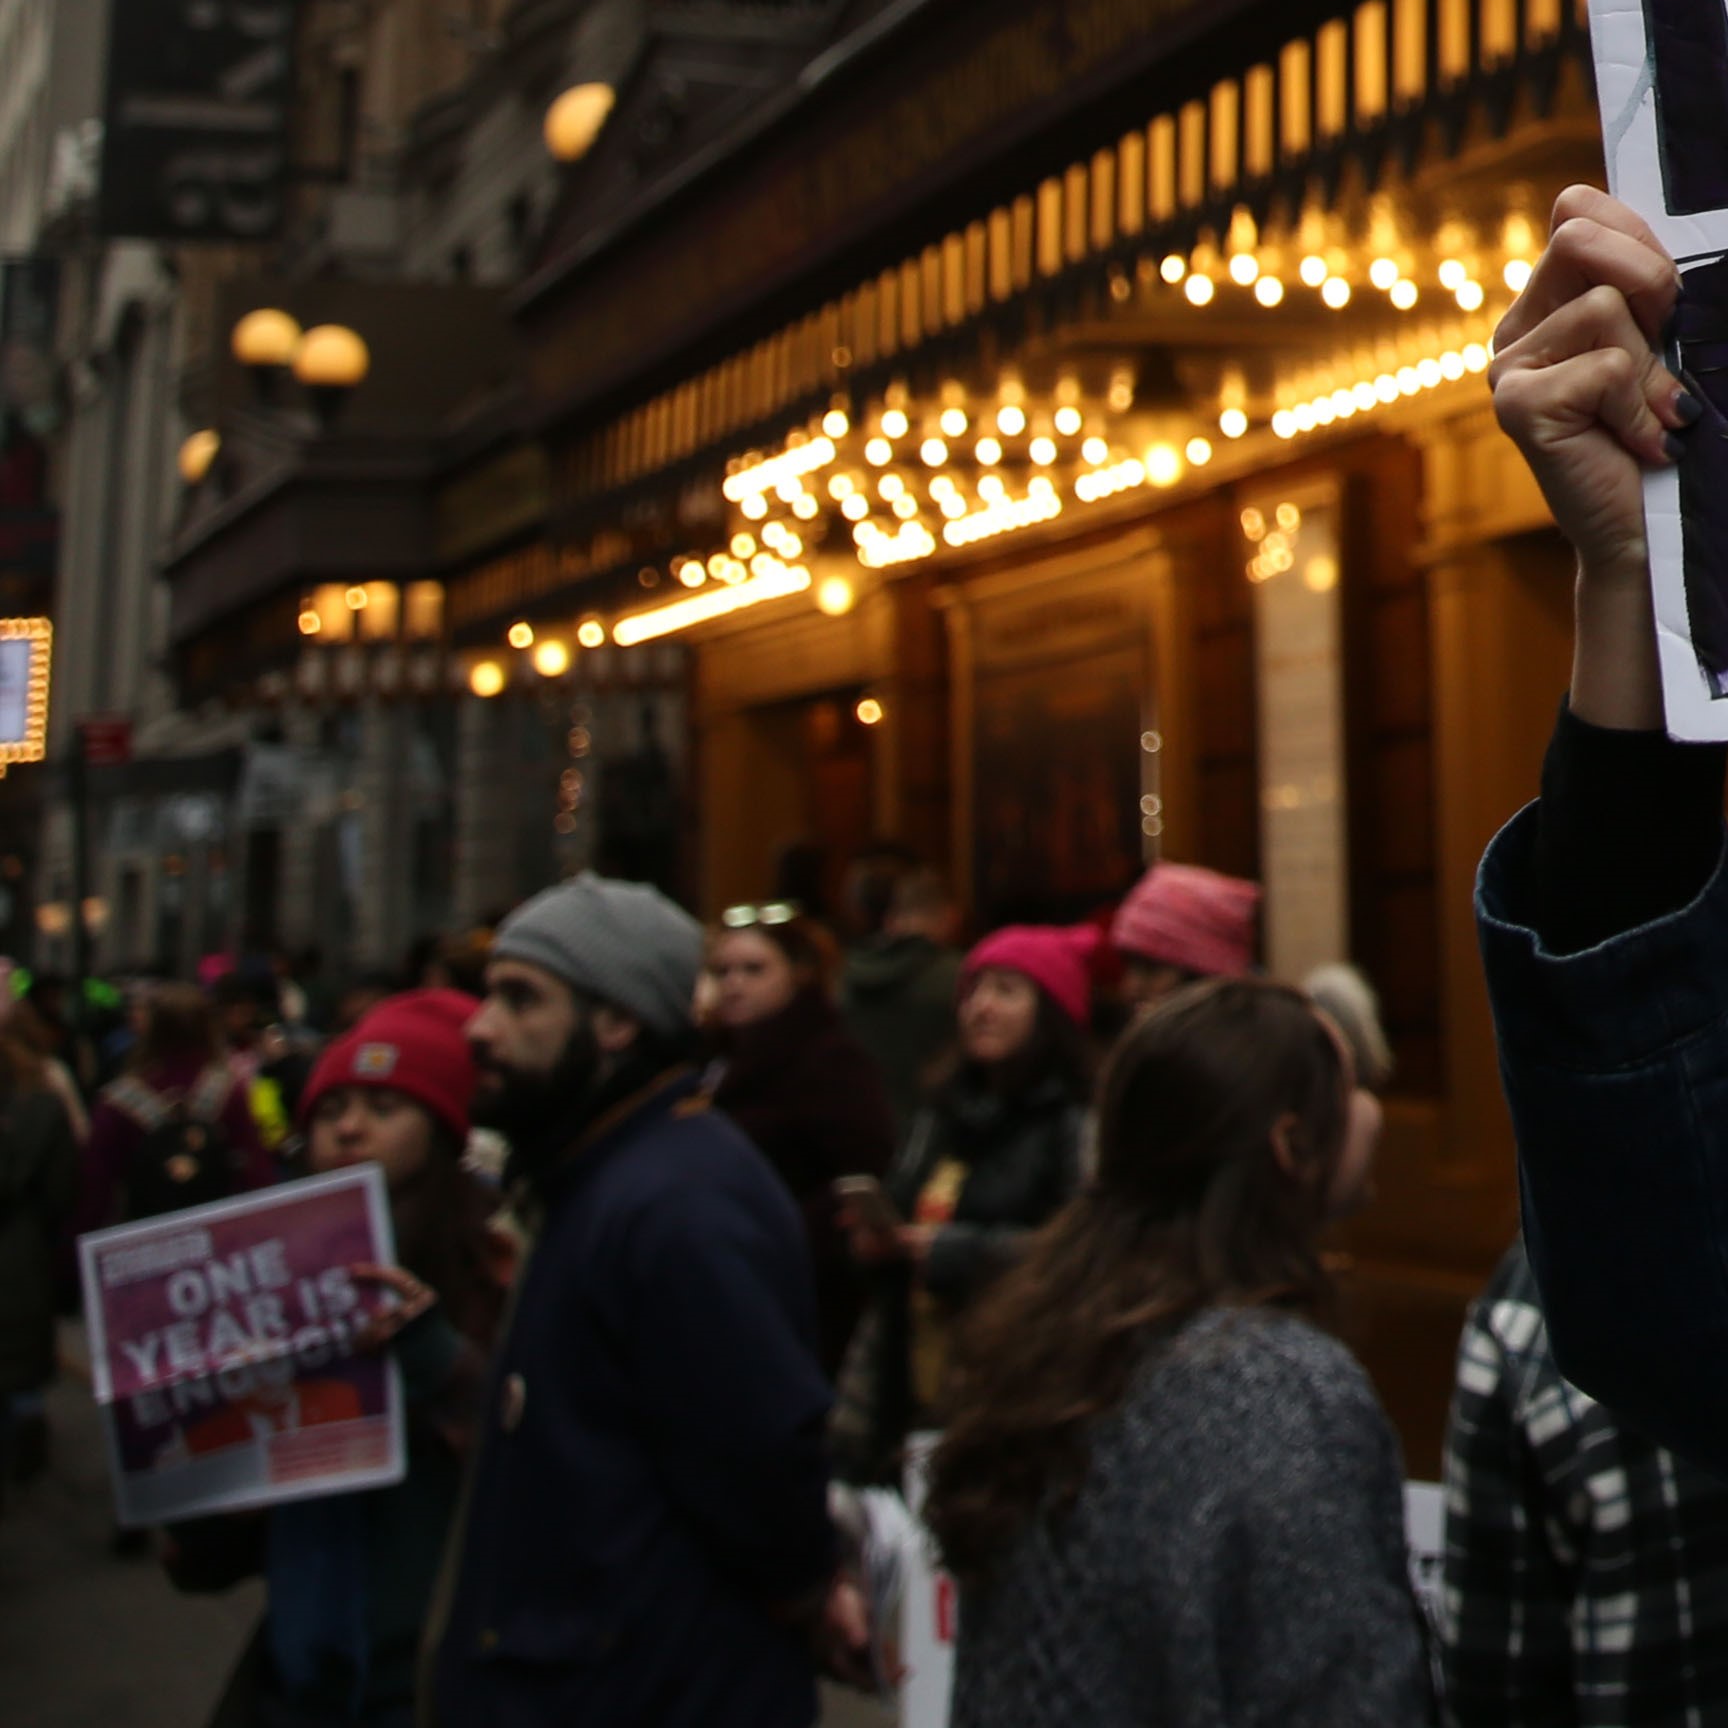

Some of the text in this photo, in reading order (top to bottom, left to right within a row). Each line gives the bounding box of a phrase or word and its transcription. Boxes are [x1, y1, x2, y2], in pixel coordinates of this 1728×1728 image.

[121, 1266, 360, 1385] YEAR IS
[167, 1238, 292, 1318] ONE
